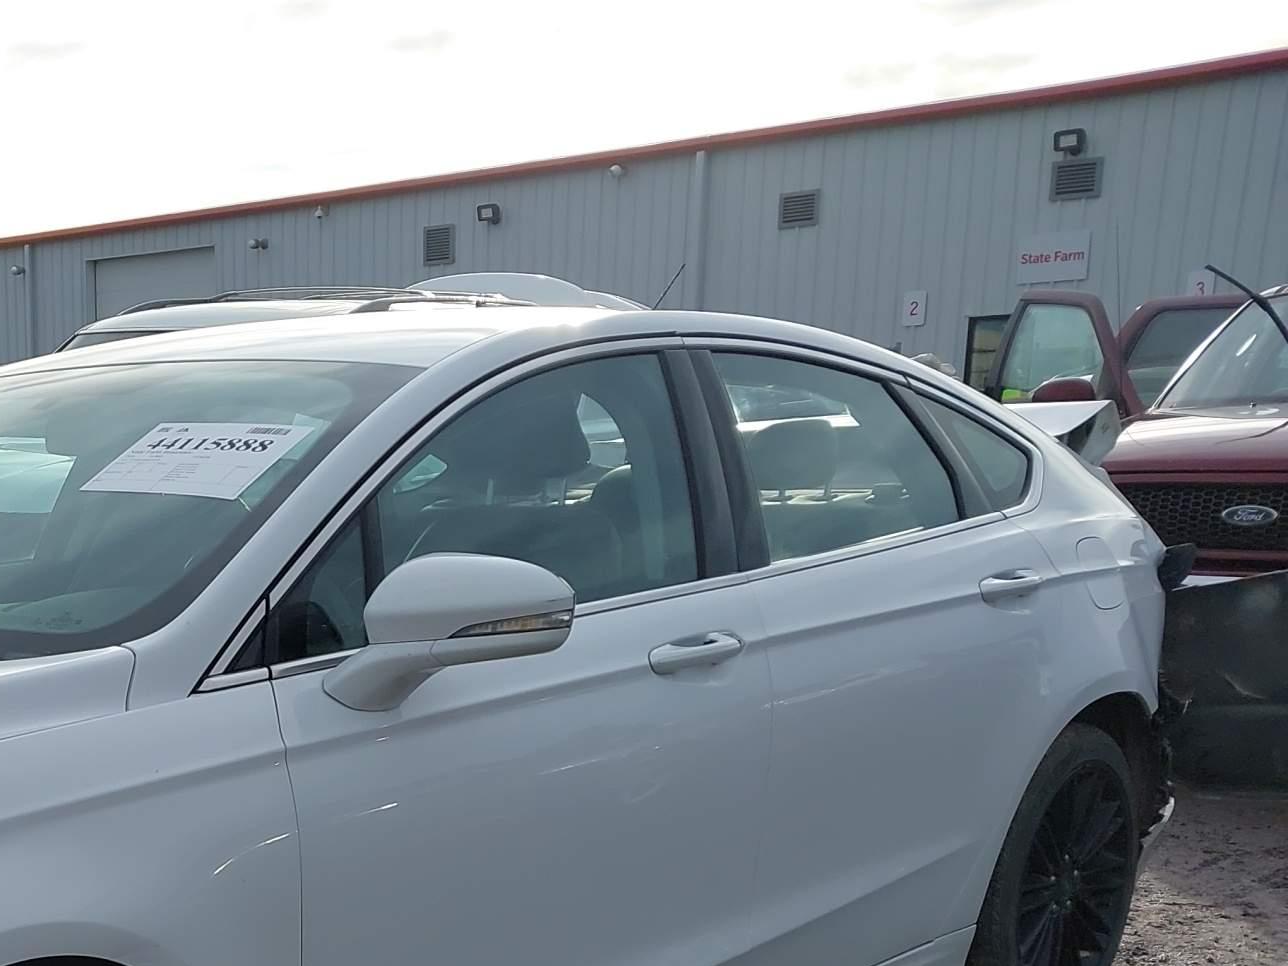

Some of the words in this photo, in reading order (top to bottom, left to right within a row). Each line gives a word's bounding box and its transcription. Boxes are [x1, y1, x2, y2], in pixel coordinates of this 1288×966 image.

[1020, 253, 1051, 265] State
[1054, 250, 1085, 262] Farm
[910, 301, 919, 316] 2
[146, 437, 275, 453] 44115888
[1234, 508, 1266, 521] Ford
